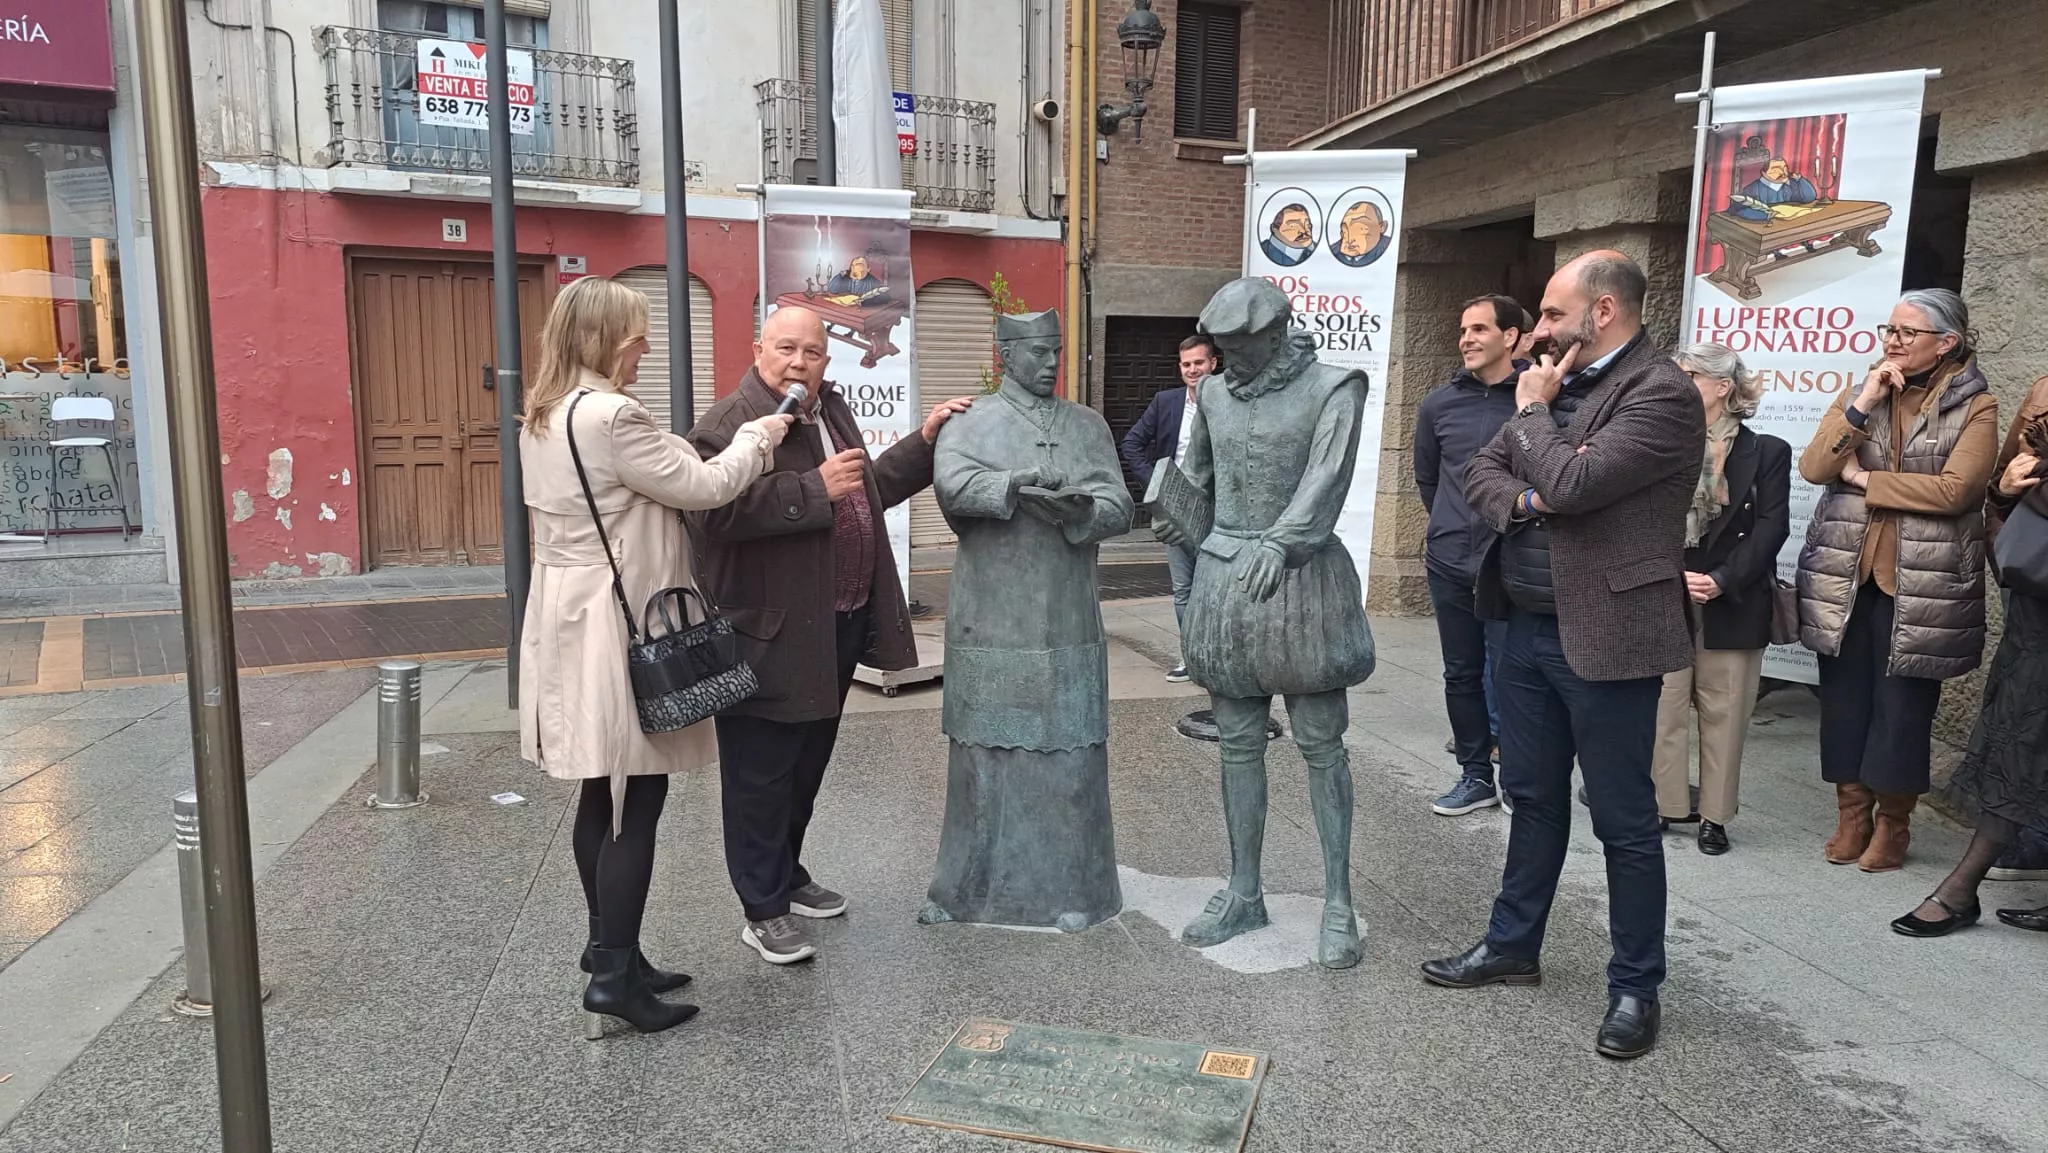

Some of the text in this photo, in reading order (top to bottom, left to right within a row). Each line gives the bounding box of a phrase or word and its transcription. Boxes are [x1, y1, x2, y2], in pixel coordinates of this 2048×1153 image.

[425, 75, 470, 96] VENTA
[426, 97, 459, 114] 638
[447, 224, 462, 237] 38
[1696, 307, 1856, 330] LUPERCIO
